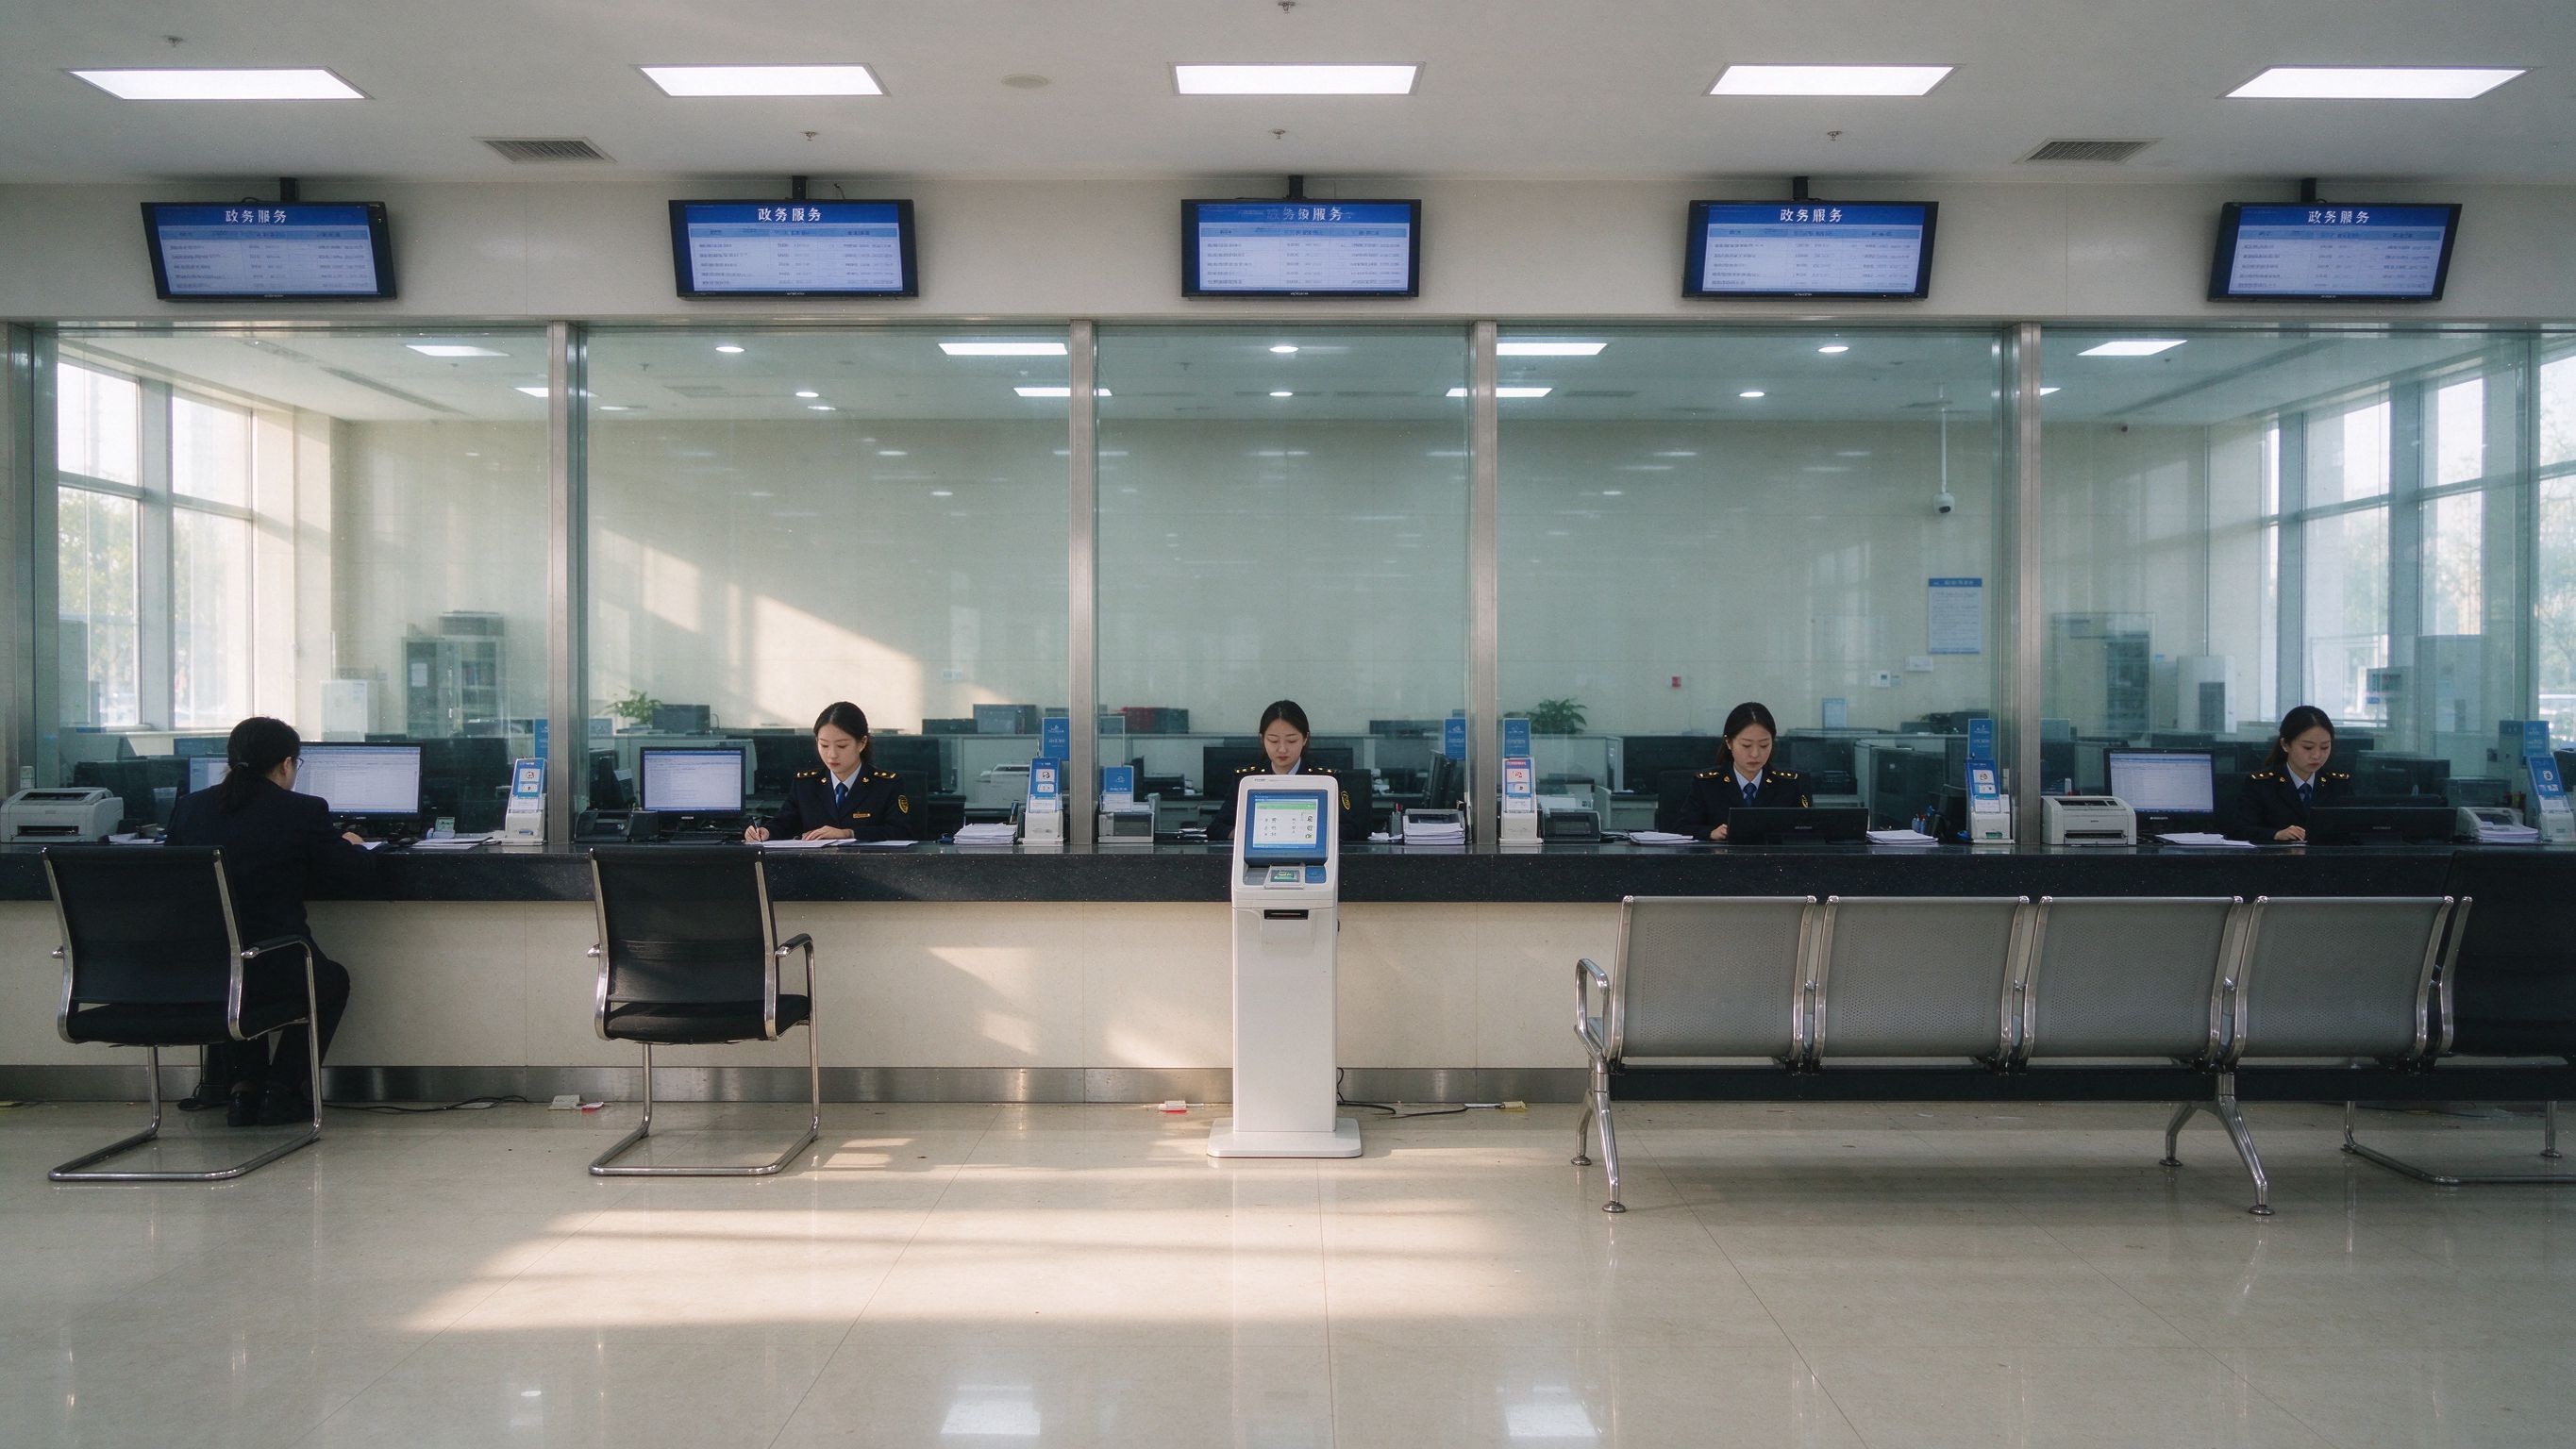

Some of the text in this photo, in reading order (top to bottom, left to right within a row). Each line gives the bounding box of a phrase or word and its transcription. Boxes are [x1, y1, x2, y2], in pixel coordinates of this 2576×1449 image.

[226, 209, 287, 224] 政务服务
[758, 207, 822, 223] 政务服务
[1780, 208, 1843, 223] 政务服务
[2308, 210, 2370, 224] 政务服务
